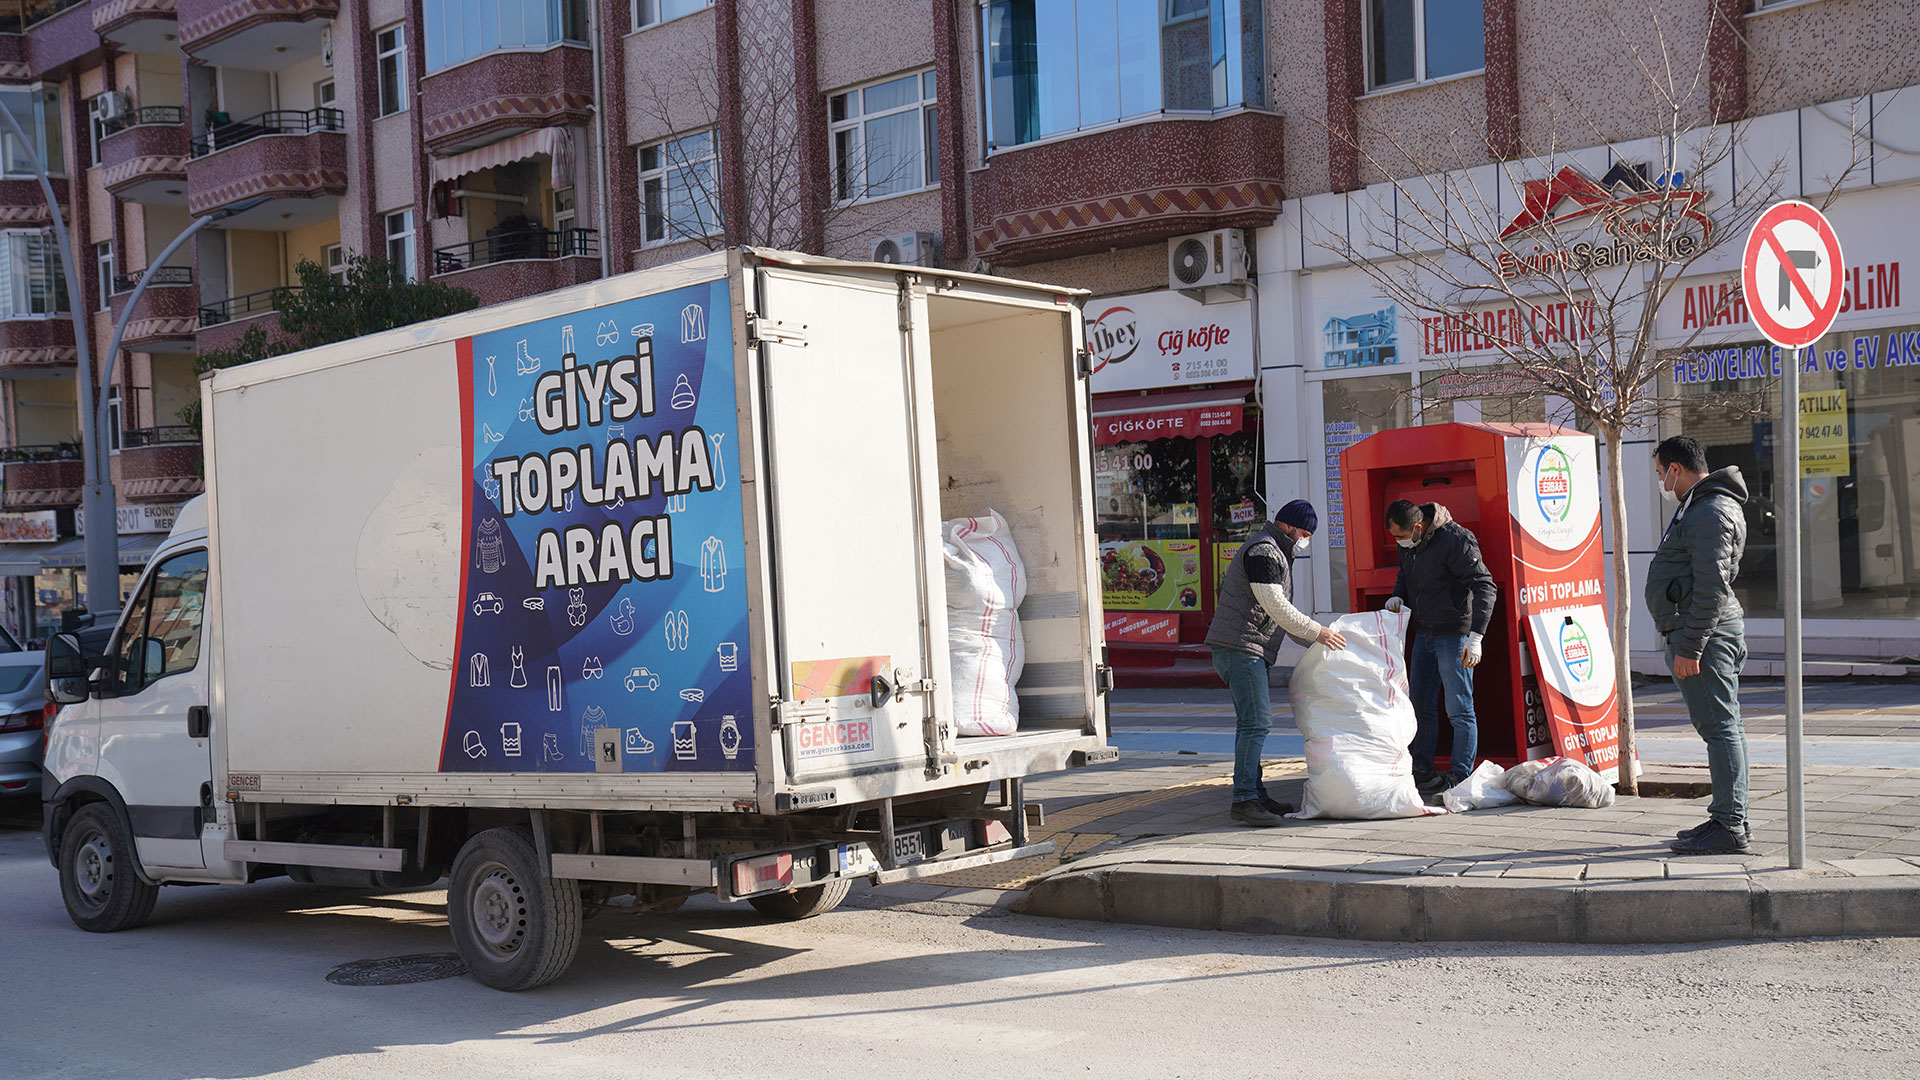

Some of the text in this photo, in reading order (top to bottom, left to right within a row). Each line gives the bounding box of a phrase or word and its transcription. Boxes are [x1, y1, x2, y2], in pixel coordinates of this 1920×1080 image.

[1157, 323, 1231, 356] Çiğ köfte
[1421, 307, 1523, 355] TEMELDEN
[1186, 358, 1228, 371] 715 41 00
[1770, 344, 1820, 377] EYA
[1824, 348, 1848, 372] ve
[1853, 335, 1880, 369] EV
[533, 337, 657, 434] GİYSİ
[1799, 394, 1843, 414] ATILIK
[1108, 417, 1184, 436] ÇİĞKÖFTE
[1805, 425, 1821, 439] 942
[1822, 425, 1832, 438] 47
[1833, 423, 1844, 437] 40
[492, 425, 715, 518] TOPLAMA
[1112, 455, 1131, 471] 41
[1133, 453, 1153, 470] 00
[1233, 509, 1253, 520] AÇIK
[534, 513, 674, 590] ARACI
[1520, 578, 1602, 605] GİYSİ TOPLAMA
[799, 721, 871, 748] GENCER
[1564, 722, 1620, 752] GİYSİ TOPLA
[800, 741, 871, 756] www.gencerkasa.com
[231, 775, 259, 786] GENCER
[847, 833, 921, 867] 34 8551
